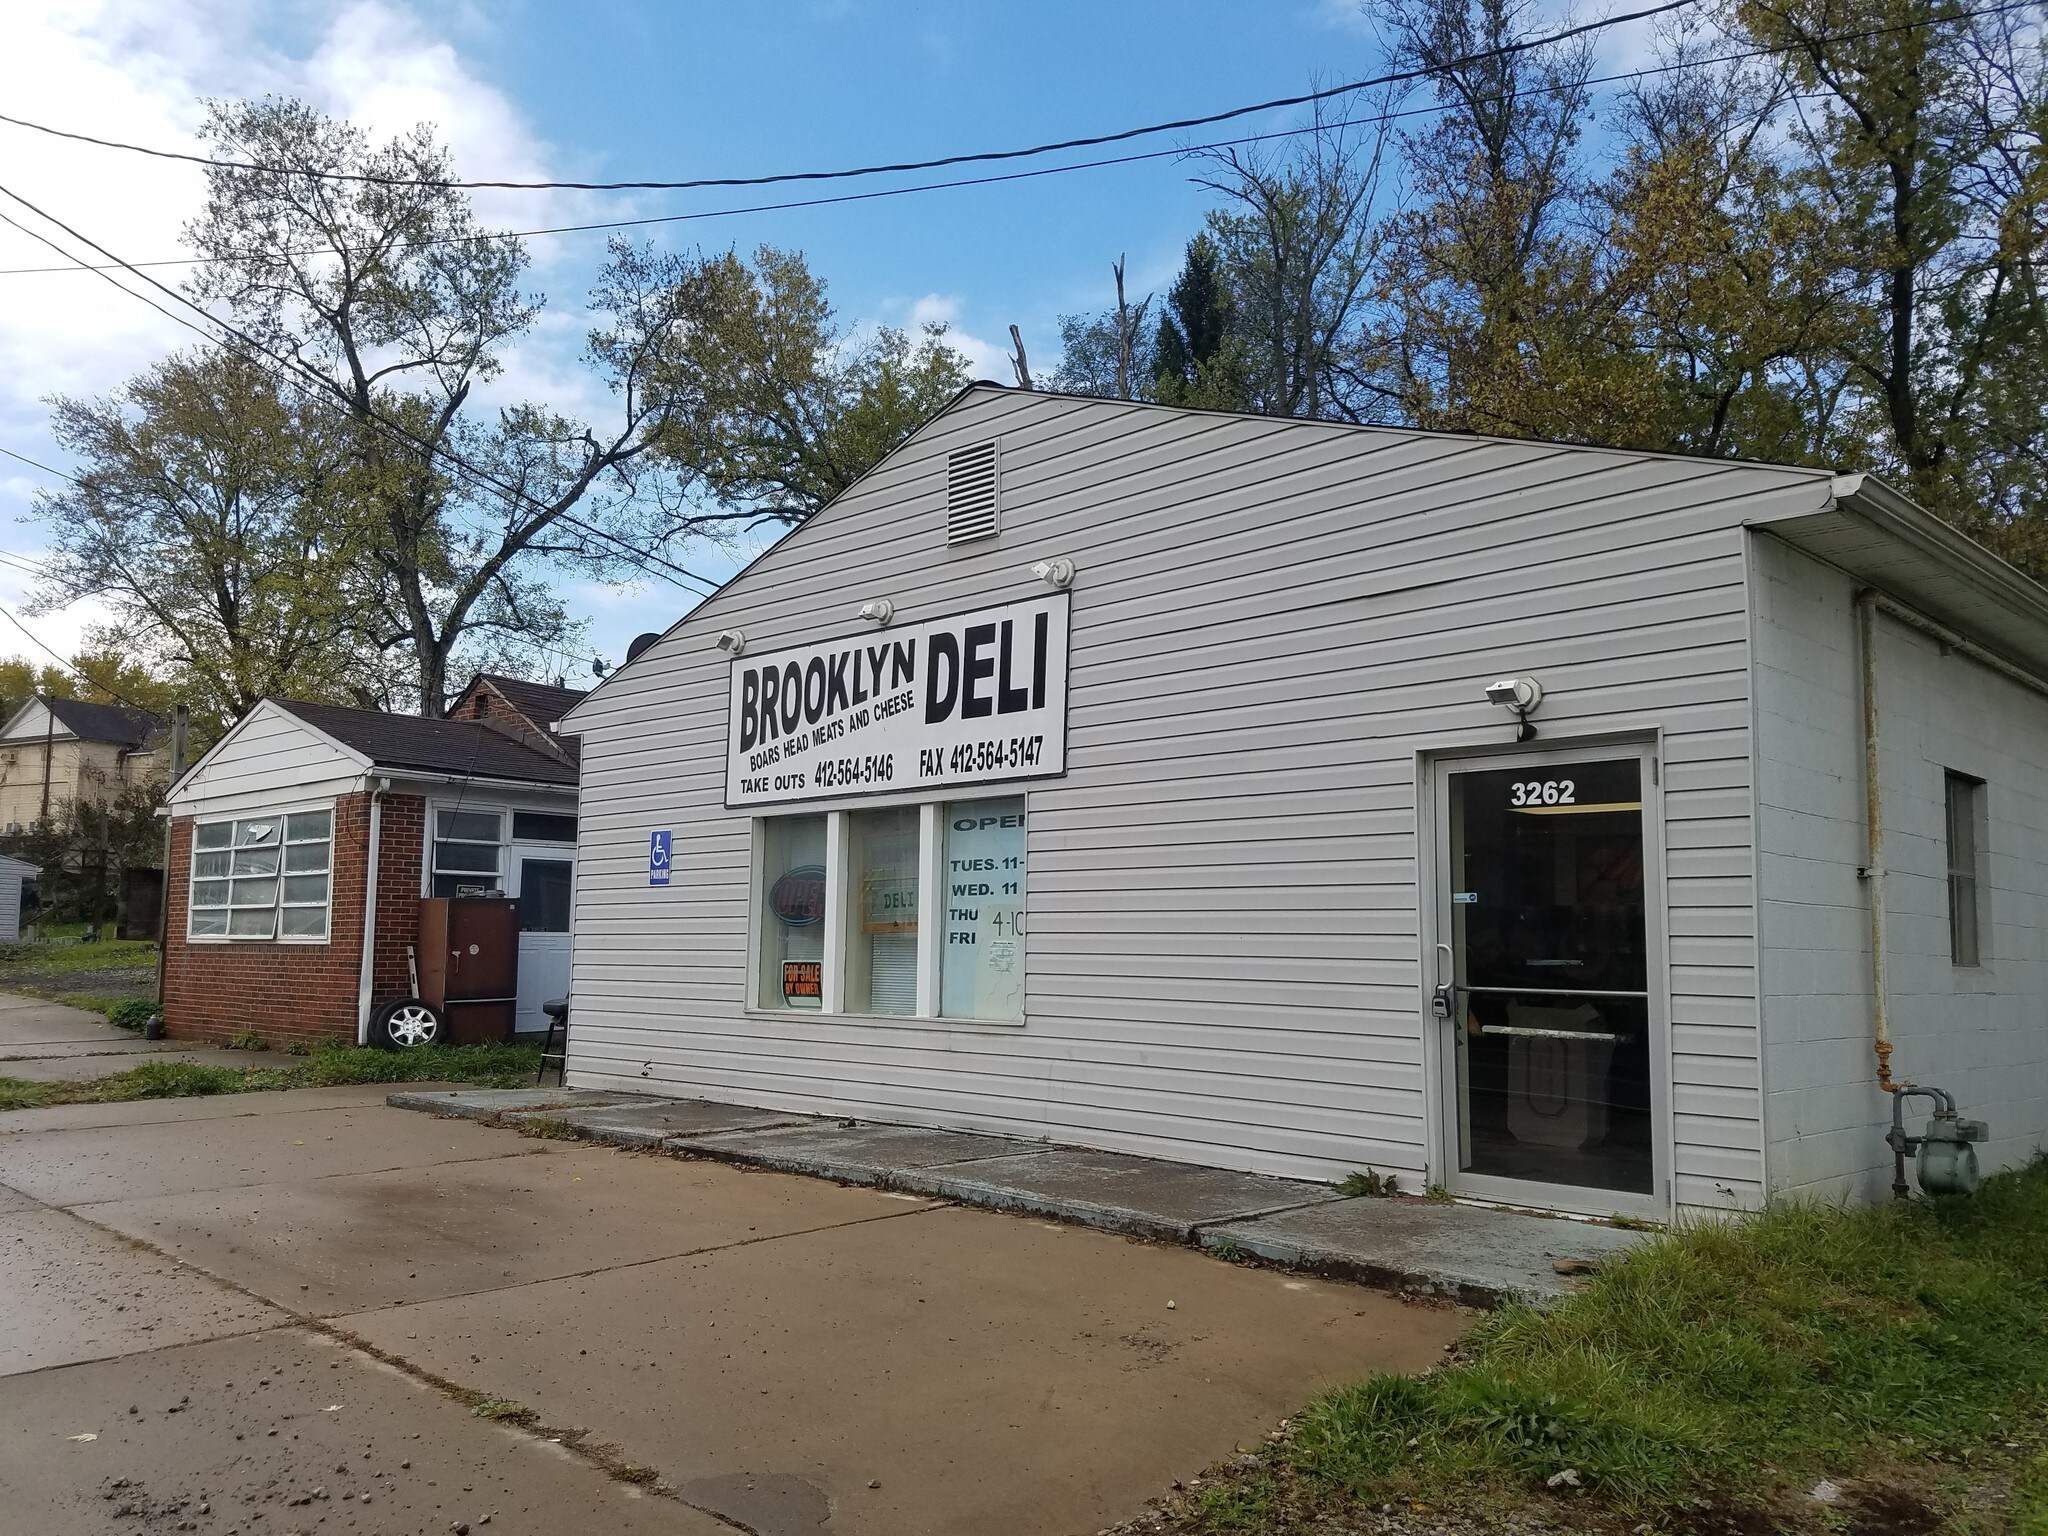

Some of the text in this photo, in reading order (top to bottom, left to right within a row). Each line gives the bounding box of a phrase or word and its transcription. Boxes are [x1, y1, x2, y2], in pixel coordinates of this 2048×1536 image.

[740, 612, 1049, 754] BROOKLYN DELI
[750, 690, 915, 772] BOARS HEAD MEATS AND CHEESE
[920, 735, 1044, 777] FAX 412-564-5147
[740, 753, 894, 794] TAKE OUTS 412-564-5146
[1511, 780, 1575, 806] 3262
[953, 814, 1025, 832] OPE
[650, 868, 669, 880] PARKING
[950, 858, 999, 872] TUES.
[952, 881, 1018, 897] WED. 11
[884, 891, 914, 909] DELI
[949, 908, 979, 921] THU
[949, 932, 976, 945] FRI
[784, 964, 820, 982] FOR SALE
[785, 982, 820, 995] BY OWNER
